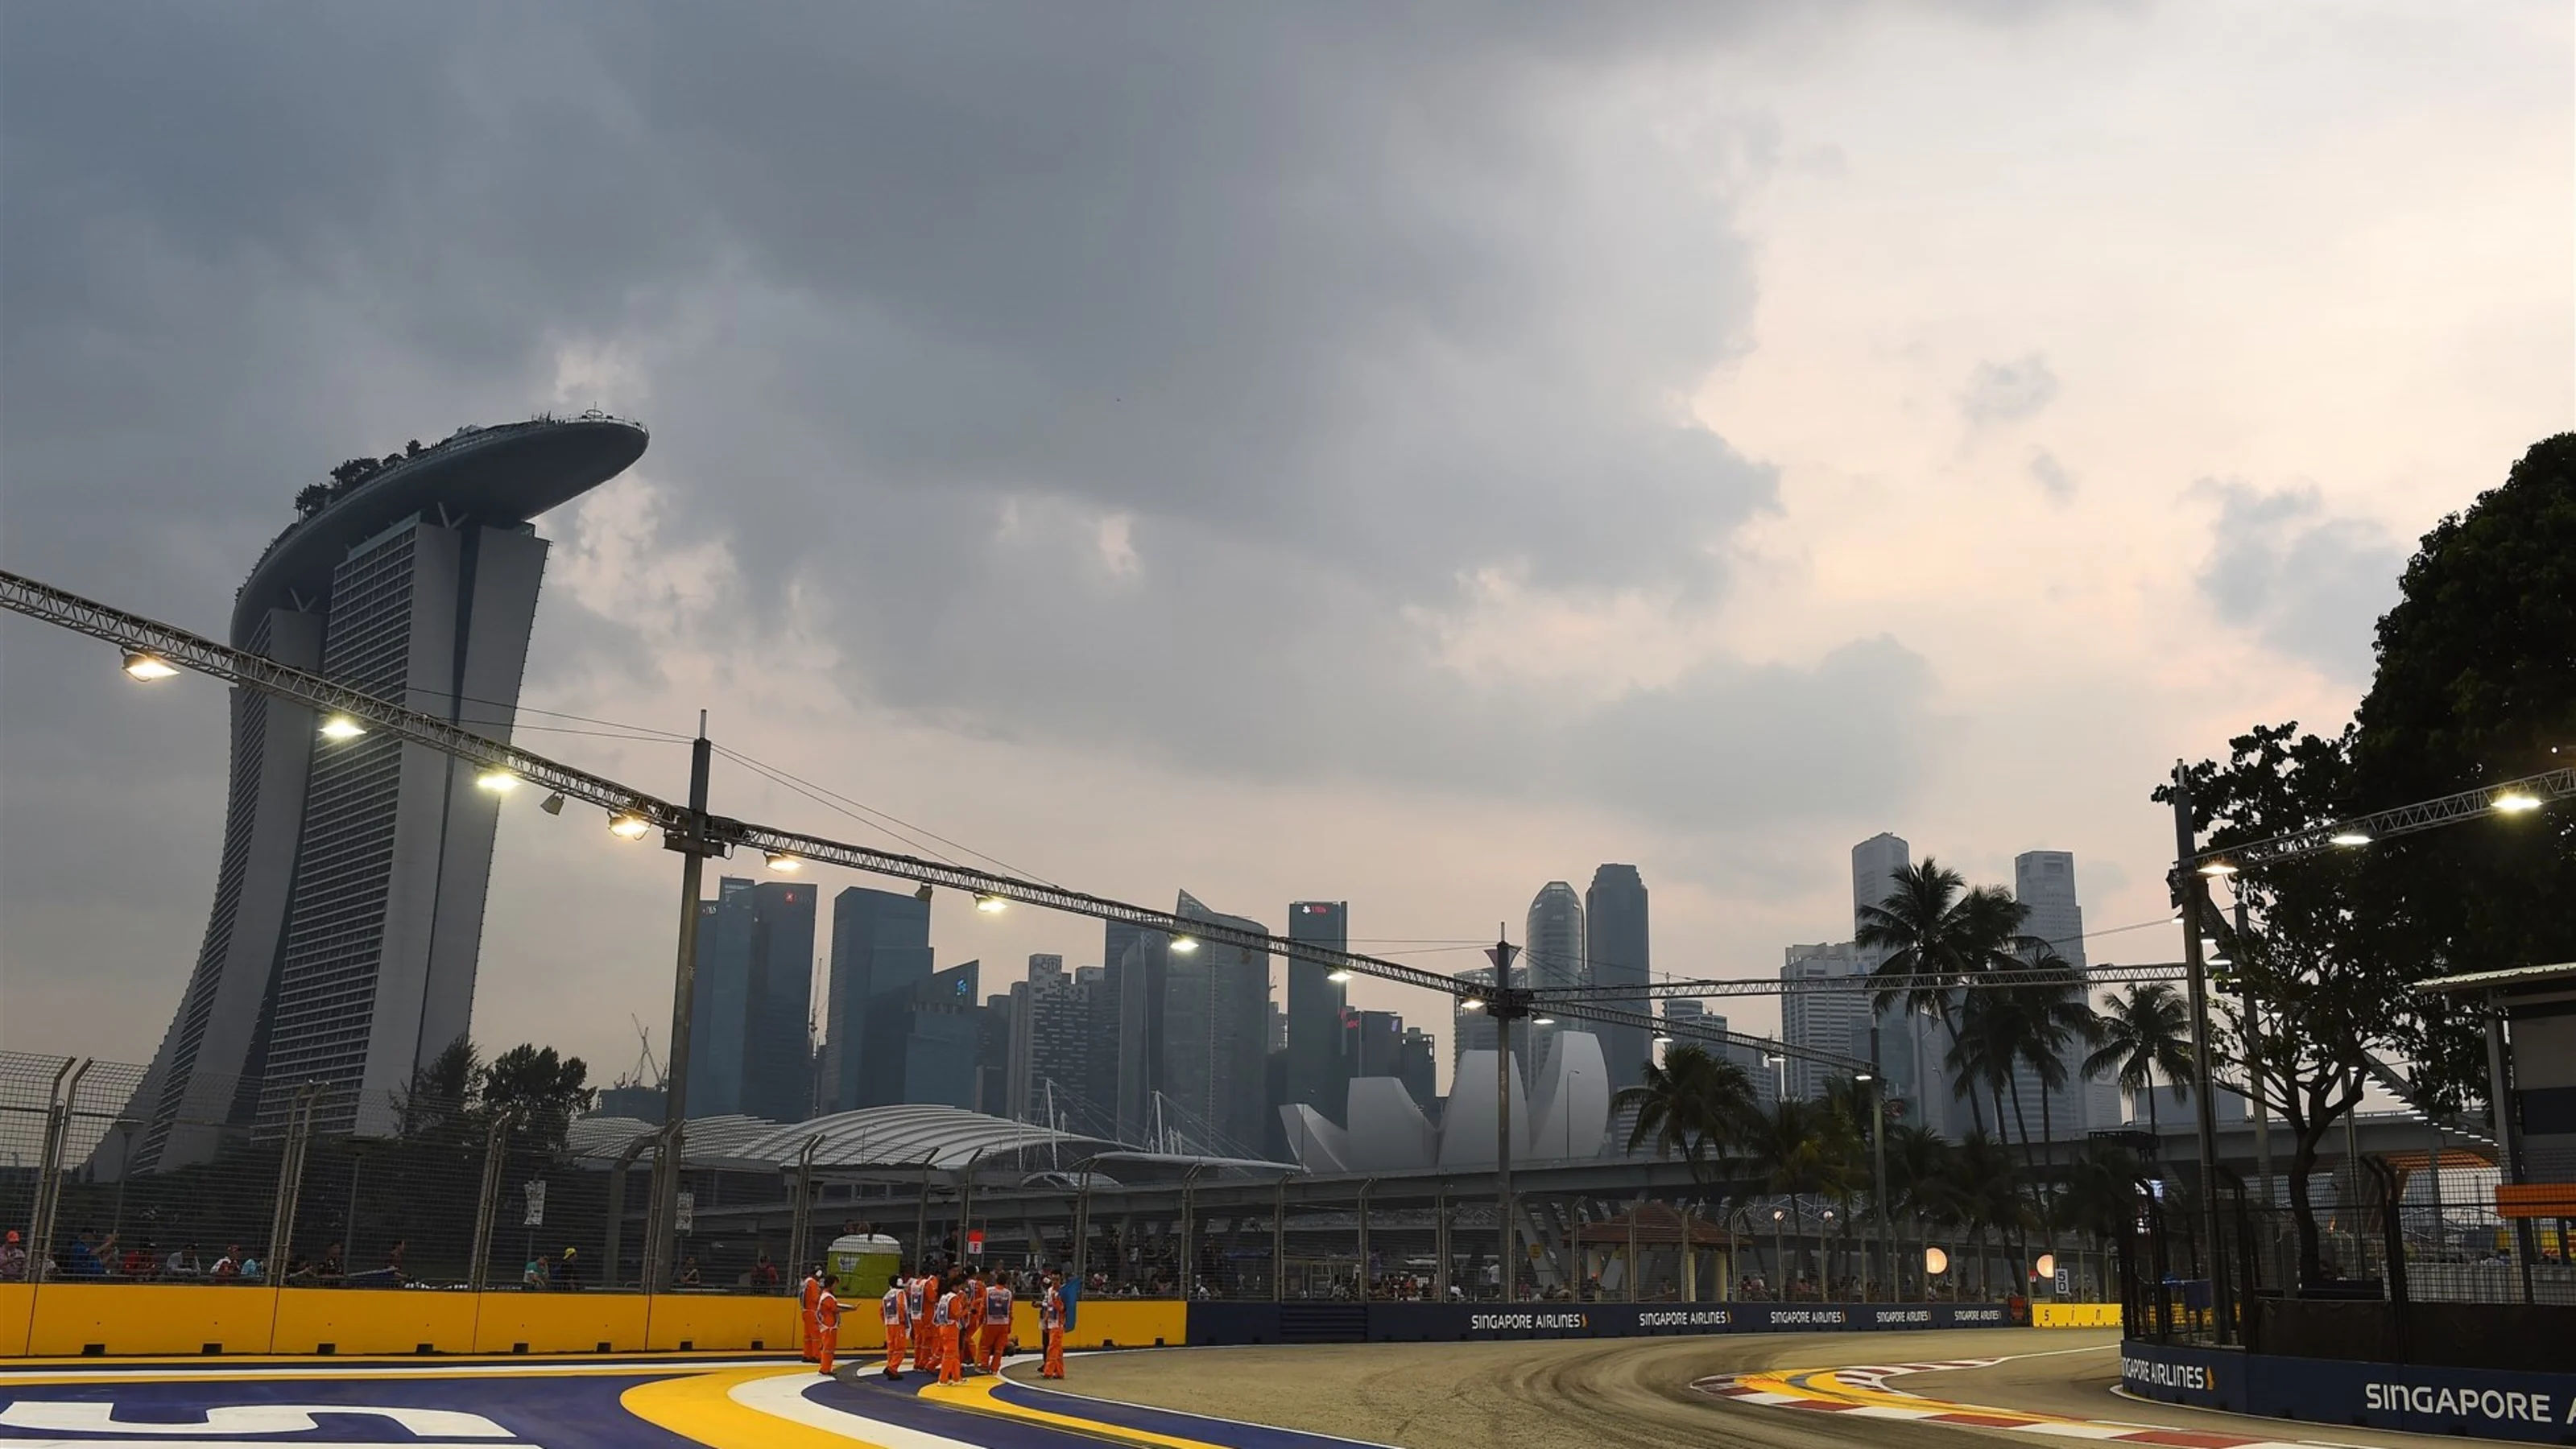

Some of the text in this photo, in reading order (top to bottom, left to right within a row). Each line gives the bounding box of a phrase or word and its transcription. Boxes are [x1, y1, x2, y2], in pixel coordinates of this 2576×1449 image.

[974, 1243, 979, 1253] F
[2057, 1271, 2066, 1291] 50
[1471, 1313, 1581, 1329] SINGAPORE AIRLINES
[1639, 1311, 1726, 1327] SINGAPORE AIRLINES
[1770, 1311, 1842, 1324] SINGAPORE AIRLINES
[2151, 1362, 2204, 1389] AIRLINES
[2365, 1383, 2553, 1423] SINGAPORE
